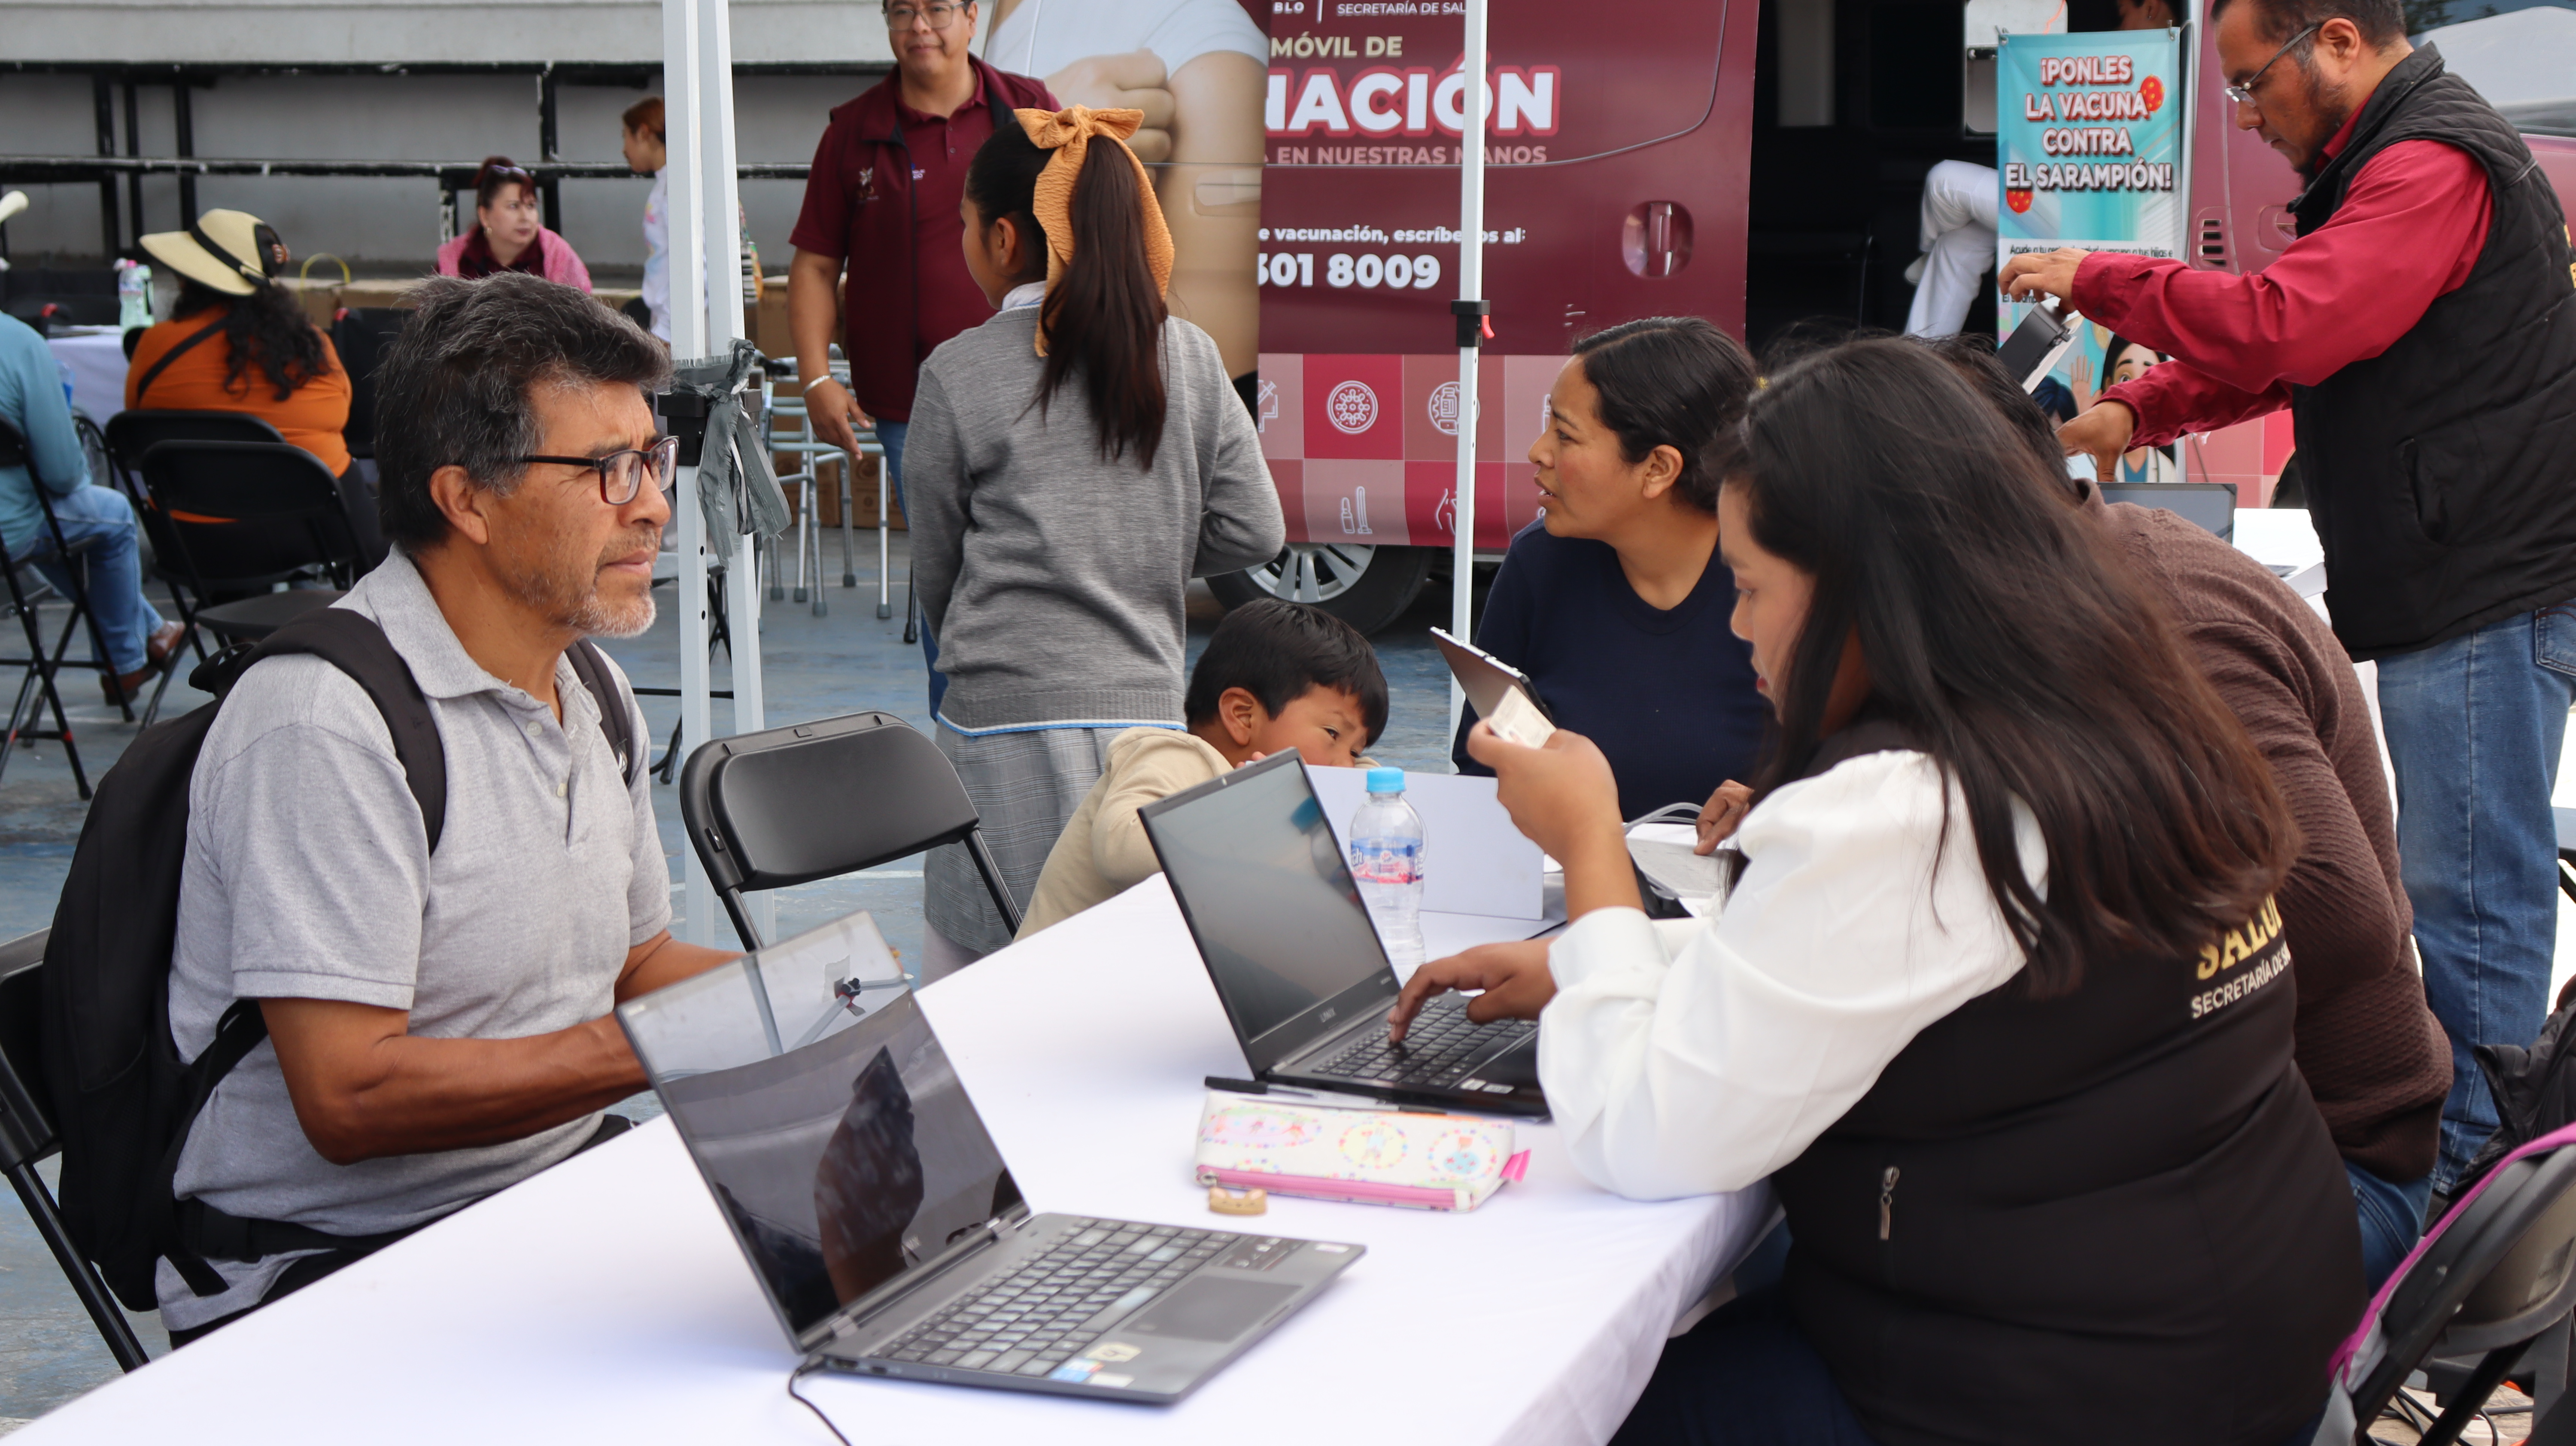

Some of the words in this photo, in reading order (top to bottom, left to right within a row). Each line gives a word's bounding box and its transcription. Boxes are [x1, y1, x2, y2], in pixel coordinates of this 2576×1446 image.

[1337, 0, 1417, 16] SECRETARÍA
[1420, 2, 1439, 15] DE
[1270, 31, 1357, 58] MÓVIL
[1364, 36, 1403, 58] DE
[2041, 56, 2132, 84] ¡PONLES
[2026, 93, 2056, 120] LA
[2058, 91, 2151, 120] VACUNA
[1277, 146, 1309, 164] EN
[1317, 146, 1447, 164] NUESTRAS
[2042, 127, 2133, 155] CONTRA
[2005, 163, 2032, 189] EL
[2036, 156, 2172, 190] SARAMPIÓN!
[1274, 224, 1389, 246] vacunación,
[1502, 227, 1526, 244] al:
[1326, 253, 1441, 289] 8009
[2191, 958, 2274, 1019] SECRETARÍA
